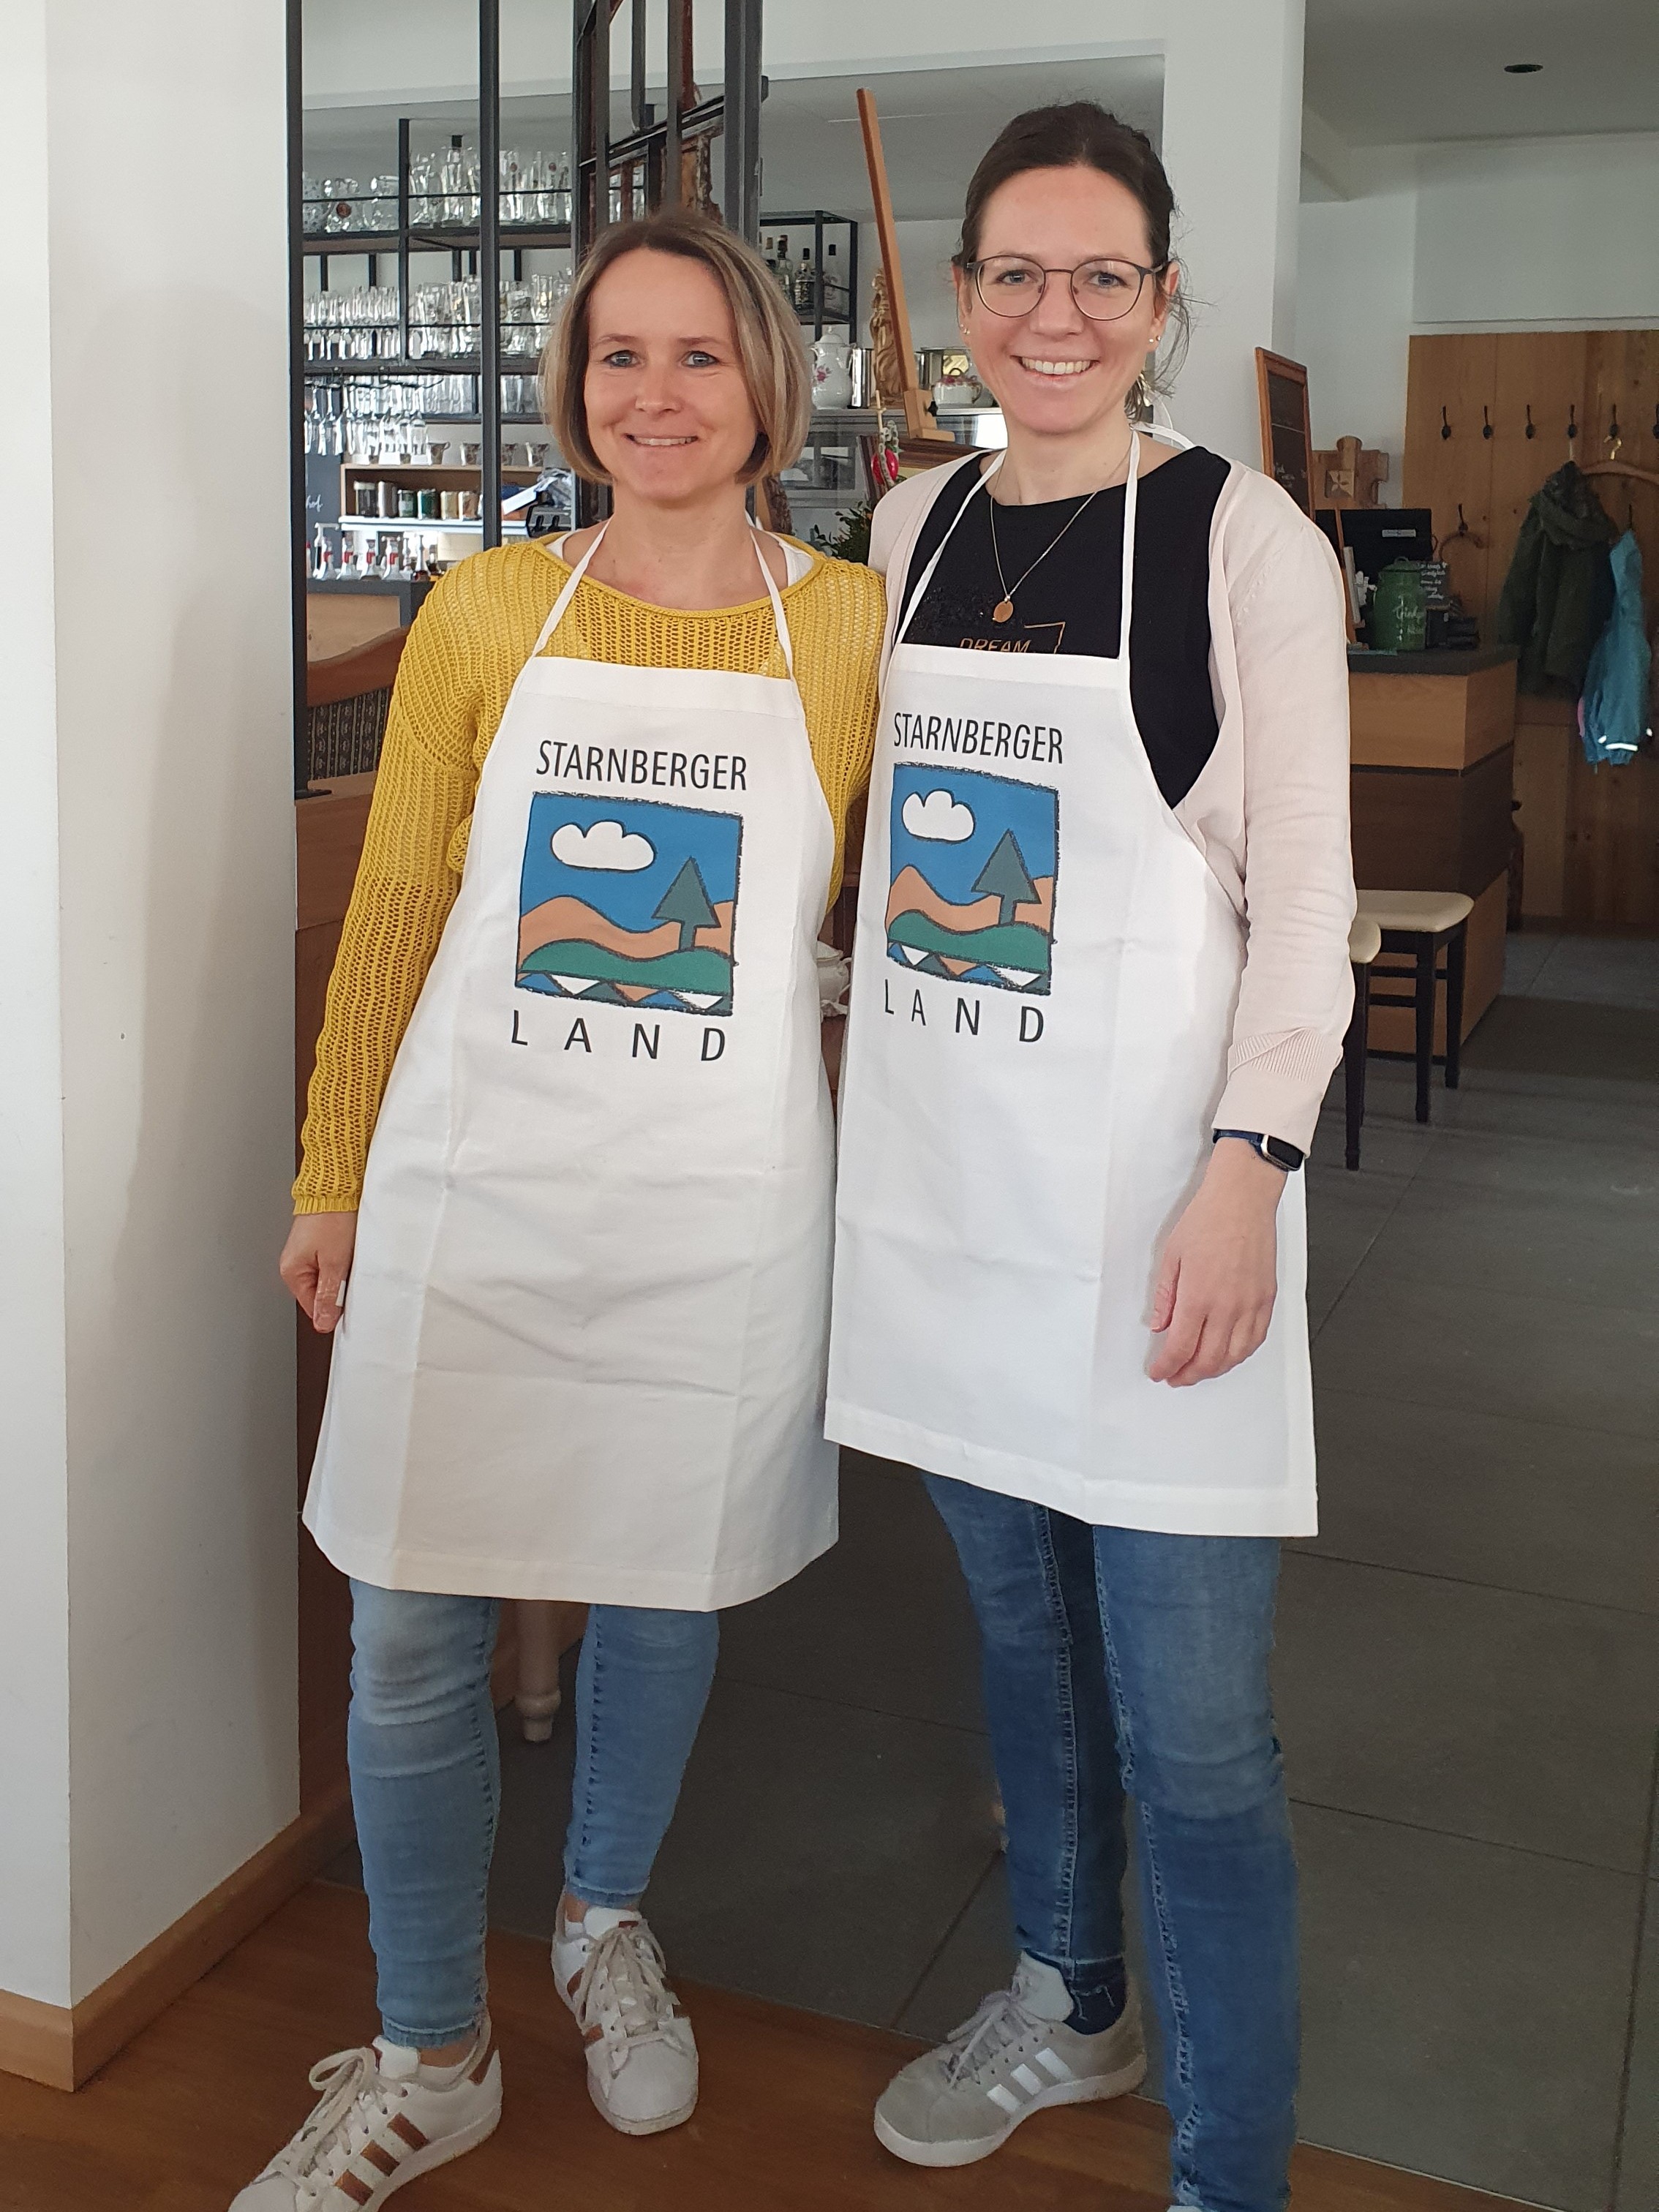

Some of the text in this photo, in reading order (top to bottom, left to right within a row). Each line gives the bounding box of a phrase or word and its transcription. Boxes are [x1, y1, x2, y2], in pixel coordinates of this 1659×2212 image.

[893, 712, 1064, 764] STARNBERGER
[535, 740, 748, 791] STARNBERGER
[511, 1009, 726, 1062] LAND
[884, 979, 1045, 1044] LAND
